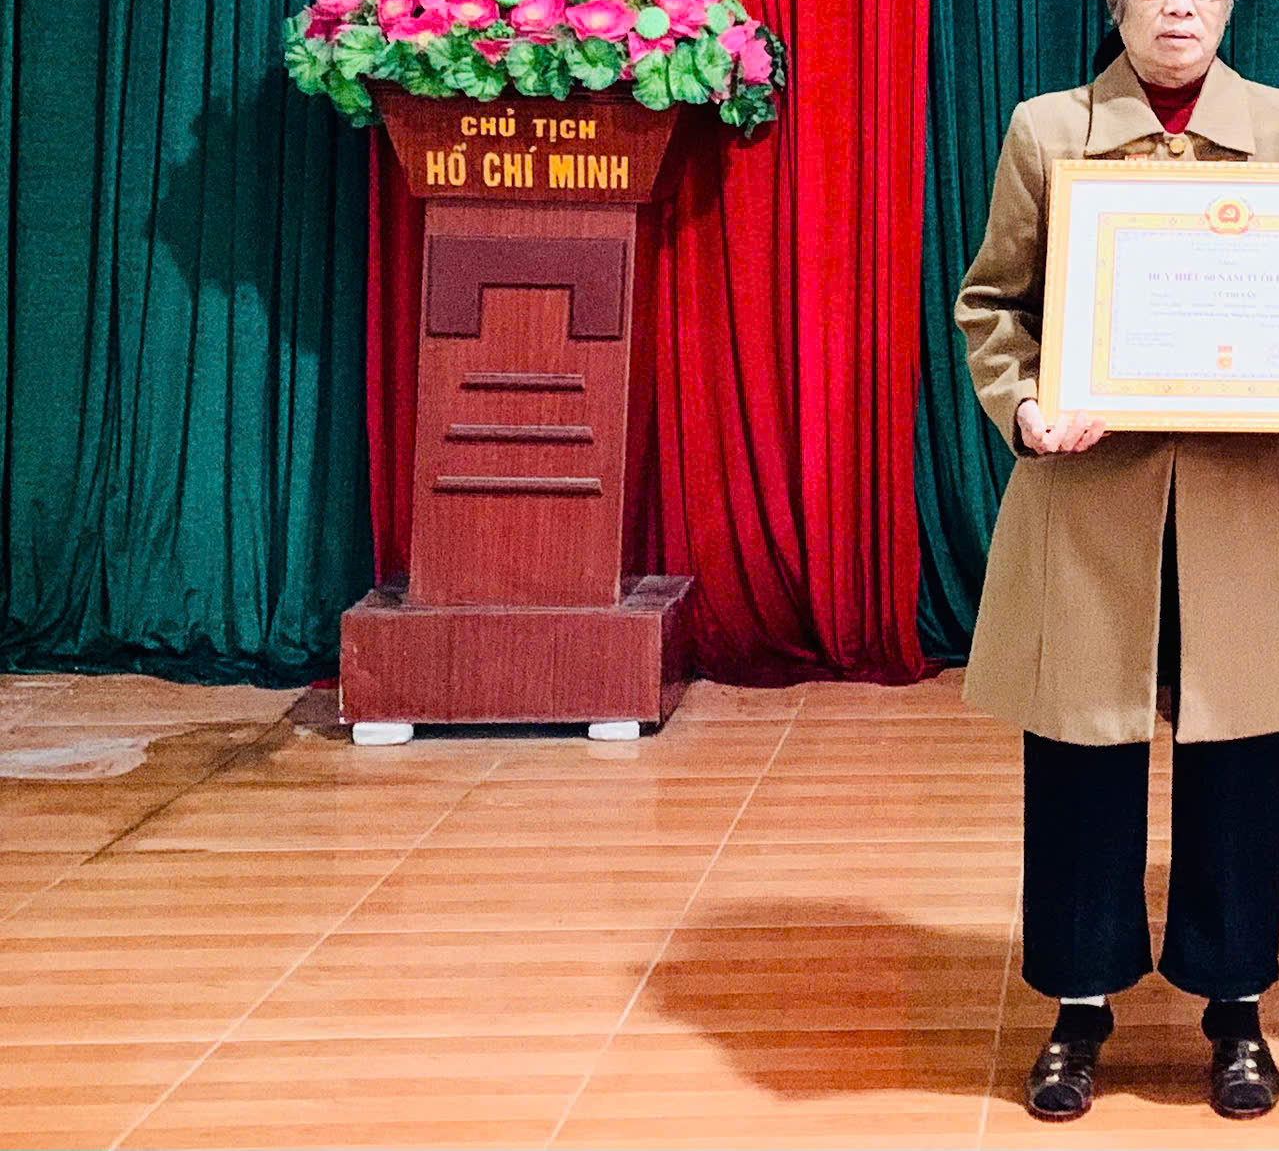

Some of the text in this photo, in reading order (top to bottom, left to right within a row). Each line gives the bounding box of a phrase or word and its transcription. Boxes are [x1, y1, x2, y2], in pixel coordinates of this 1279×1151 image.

[460, 107, 597, 142] CHỦ TỊCH
[482, 145, 537, 188] CHÍ
[548, 154, 629, 189] MINH
